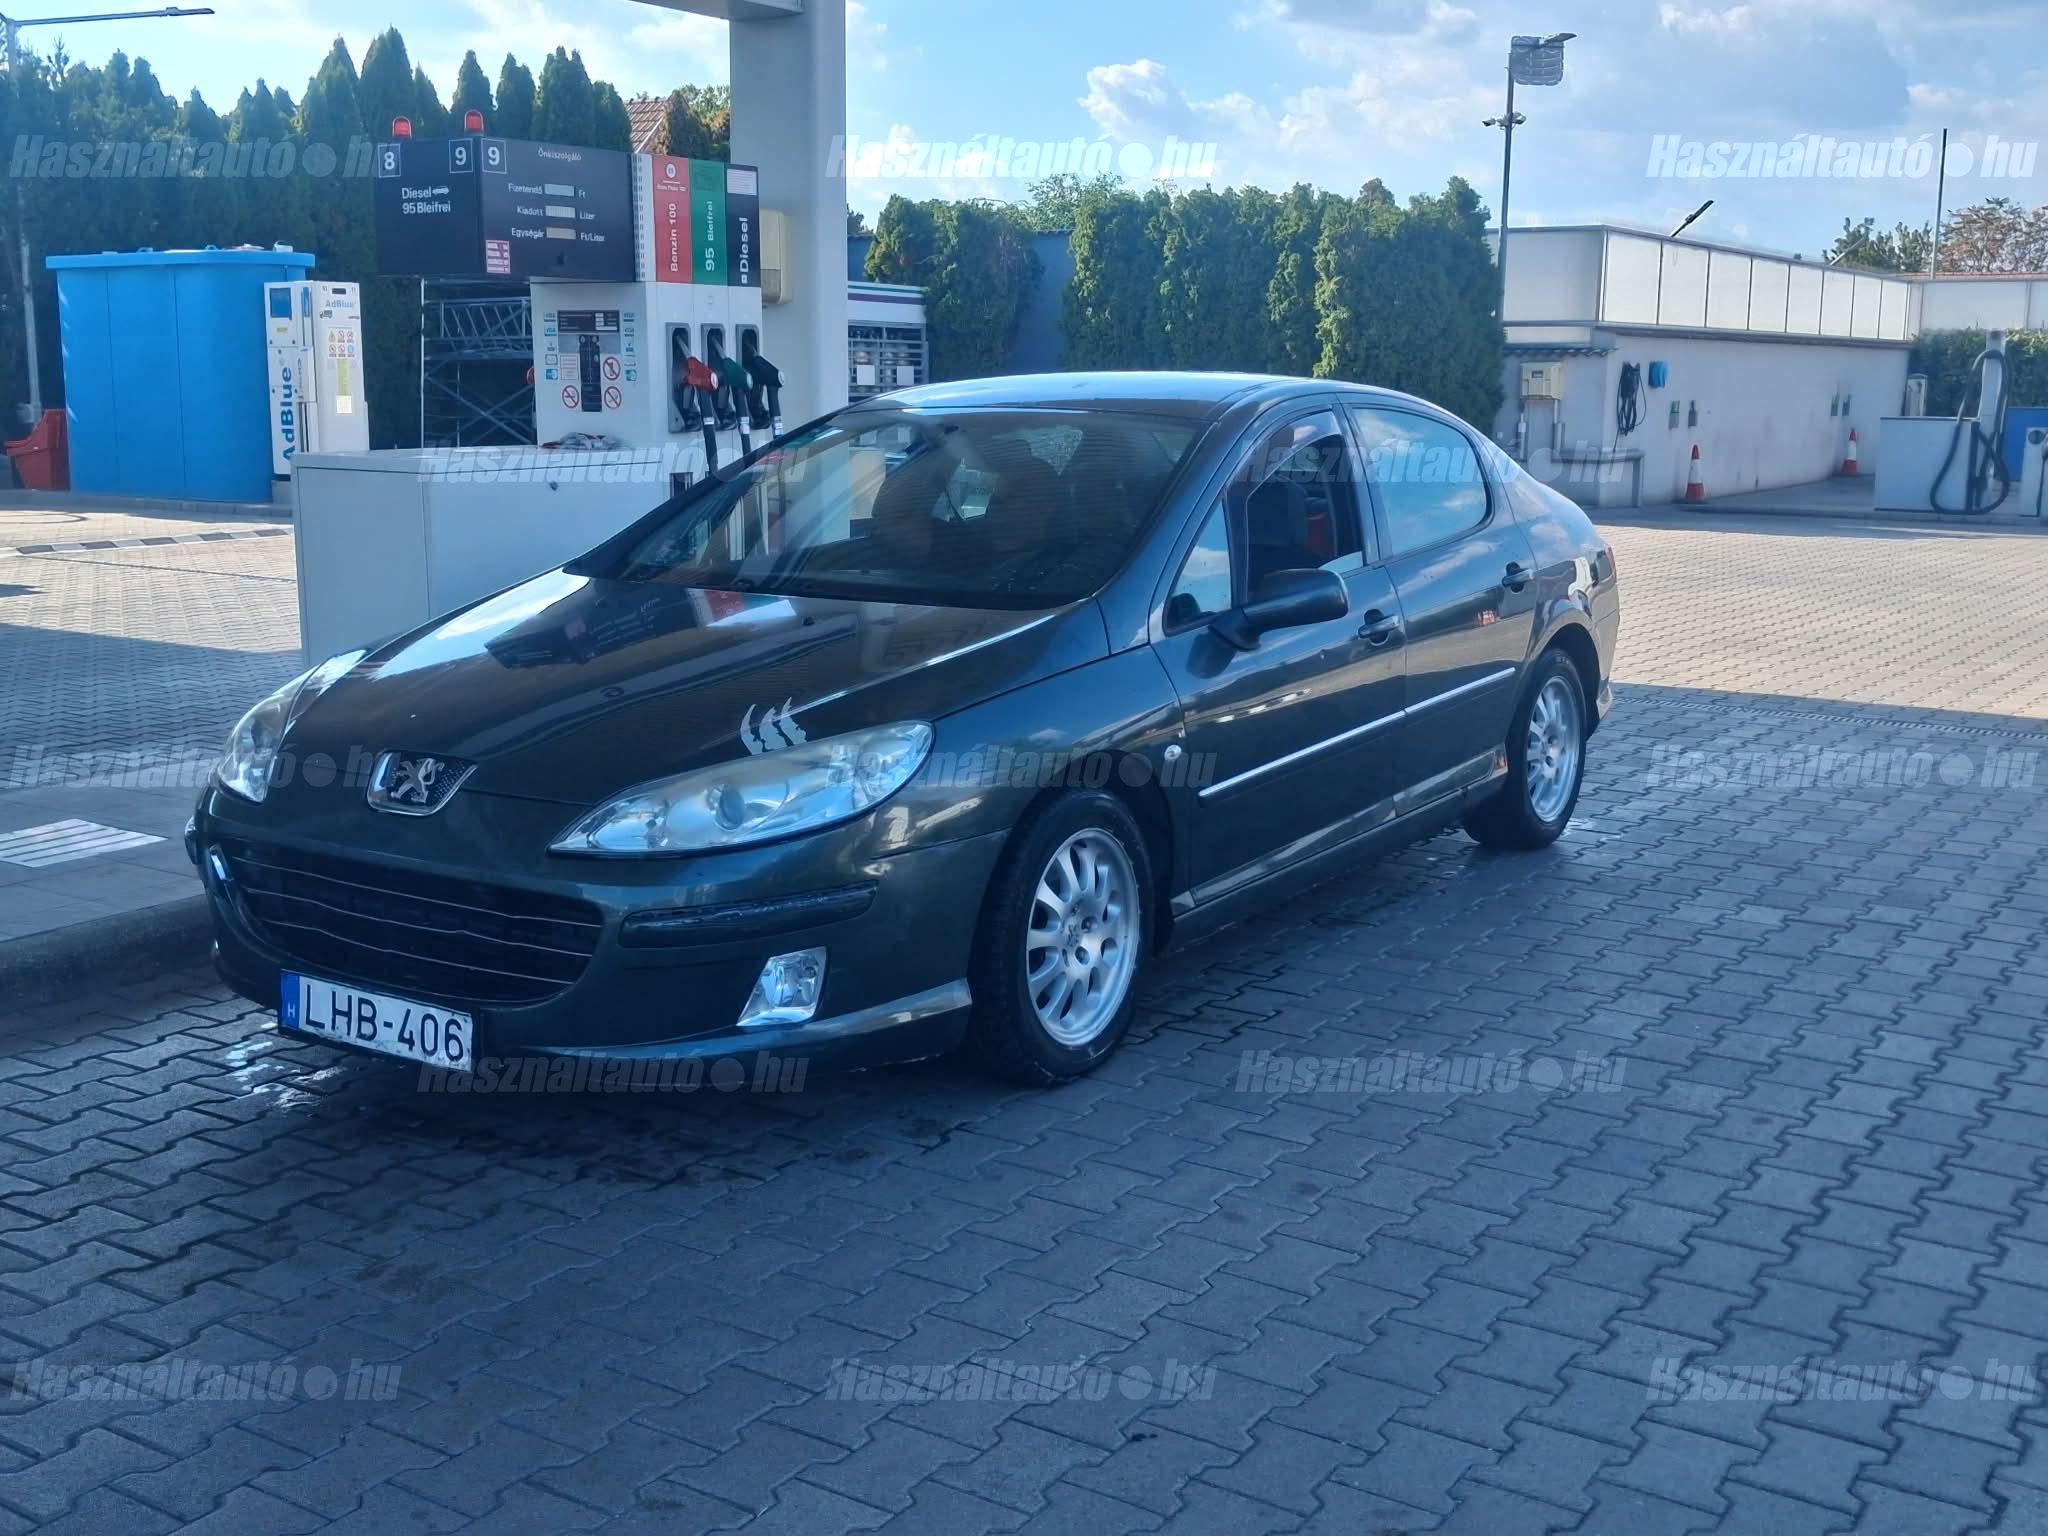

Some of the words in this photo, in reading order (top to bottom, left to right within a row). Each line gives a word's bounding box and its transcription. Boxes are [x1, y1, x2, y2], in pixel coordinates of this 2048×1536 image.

[384, 151, 396, 170] 8
[455, 147, 467, 166] 9
[487, 146, 500, 166] 9
[401, 186, 432, 200] Diesel
[402, 202, 416, 214] 95
[416, 200, 451, 214] Bleifrei
[668, 203, 677, 225] 100
[706, 200, 714, 241] Bleifrei
[670, 229, 679, 272] Benzin
[705, 247, 715, 272] 95
[280, 367, 296, 461] AdBlue
[287, 1003, 296, 1018] H
[305, 984, 464, 1061] LHB-406
